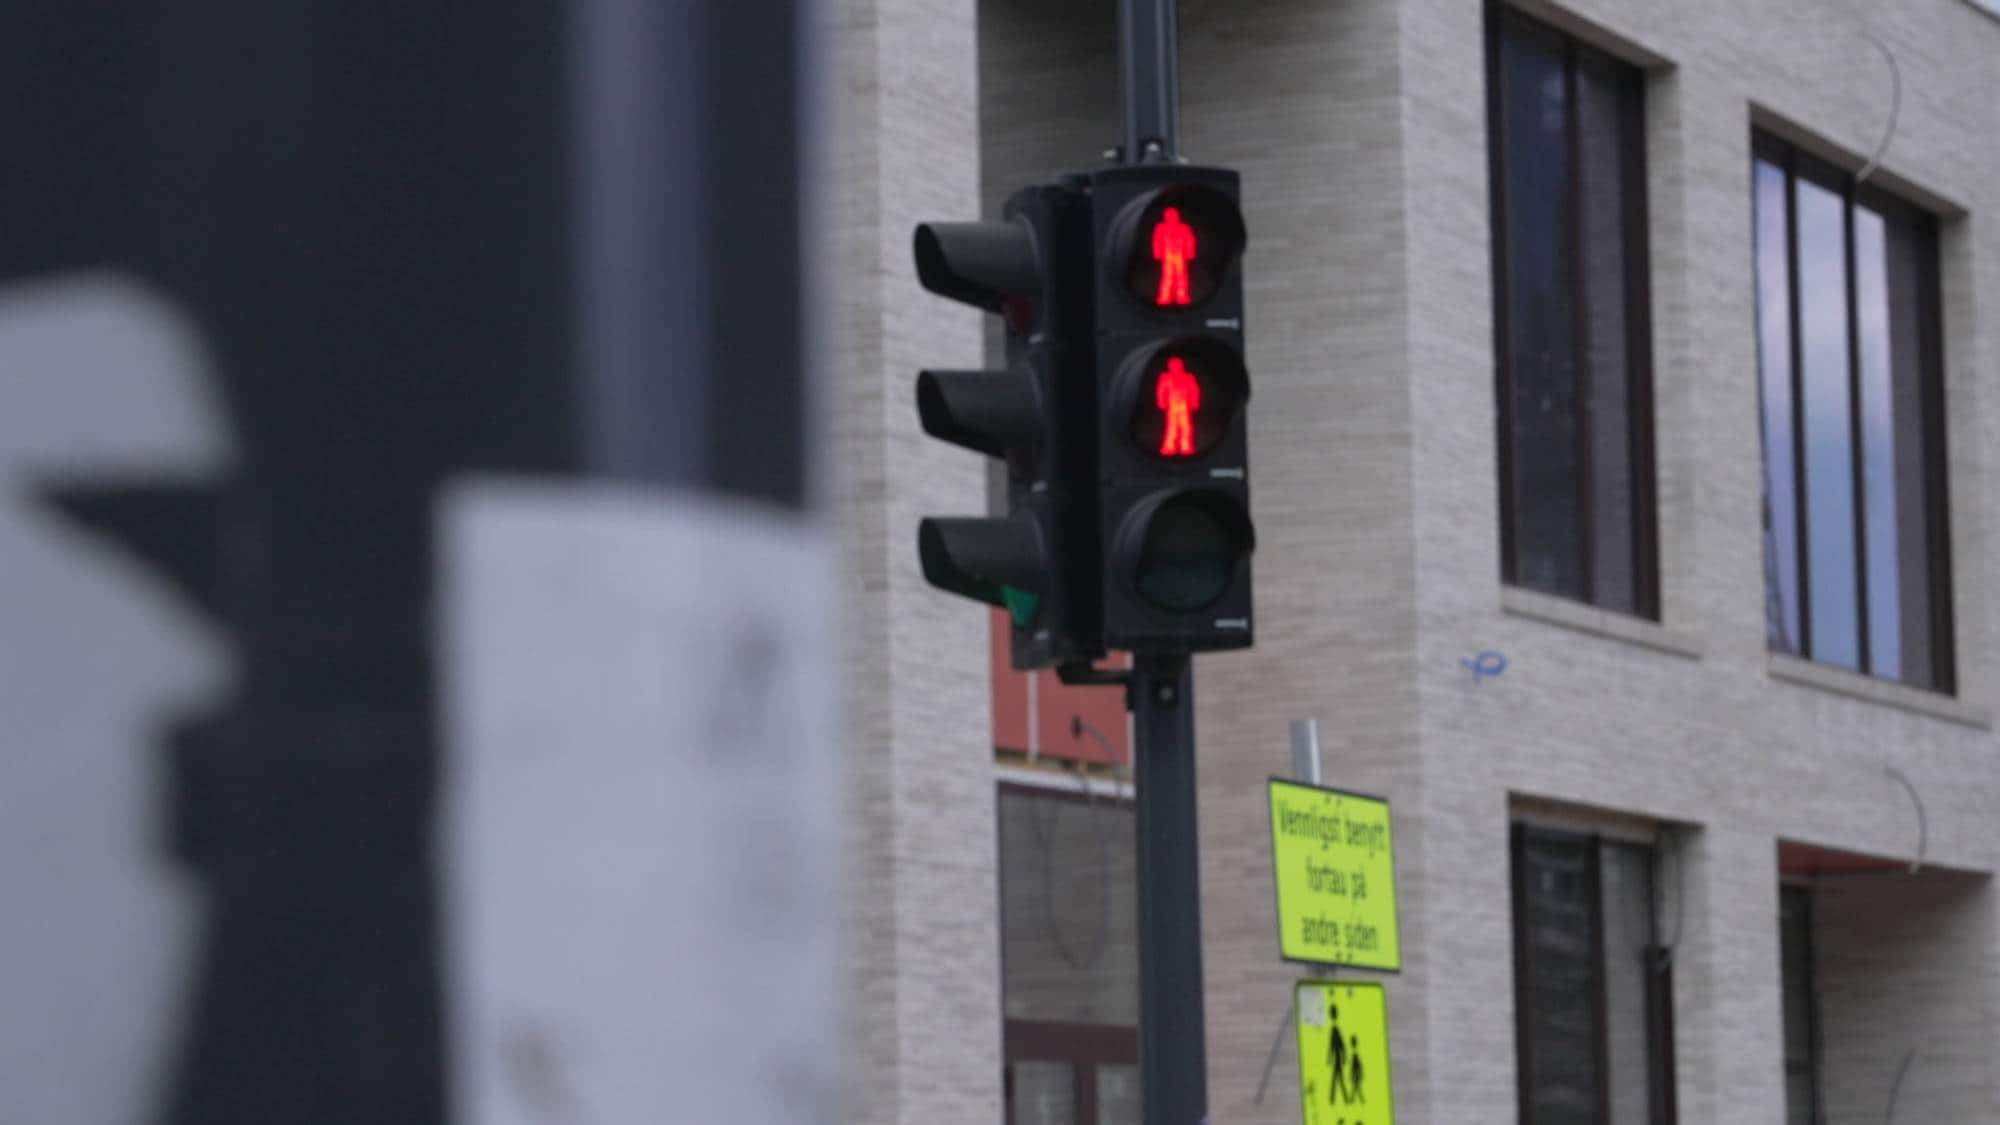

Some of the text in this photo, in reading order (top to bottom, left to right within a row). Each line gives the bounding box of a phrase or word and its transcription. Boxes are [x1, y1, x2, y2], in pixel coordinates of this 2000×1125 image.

[1305, 856, 1367, 903] fortau på
[1302, 911, 1377, 949] andre siden
